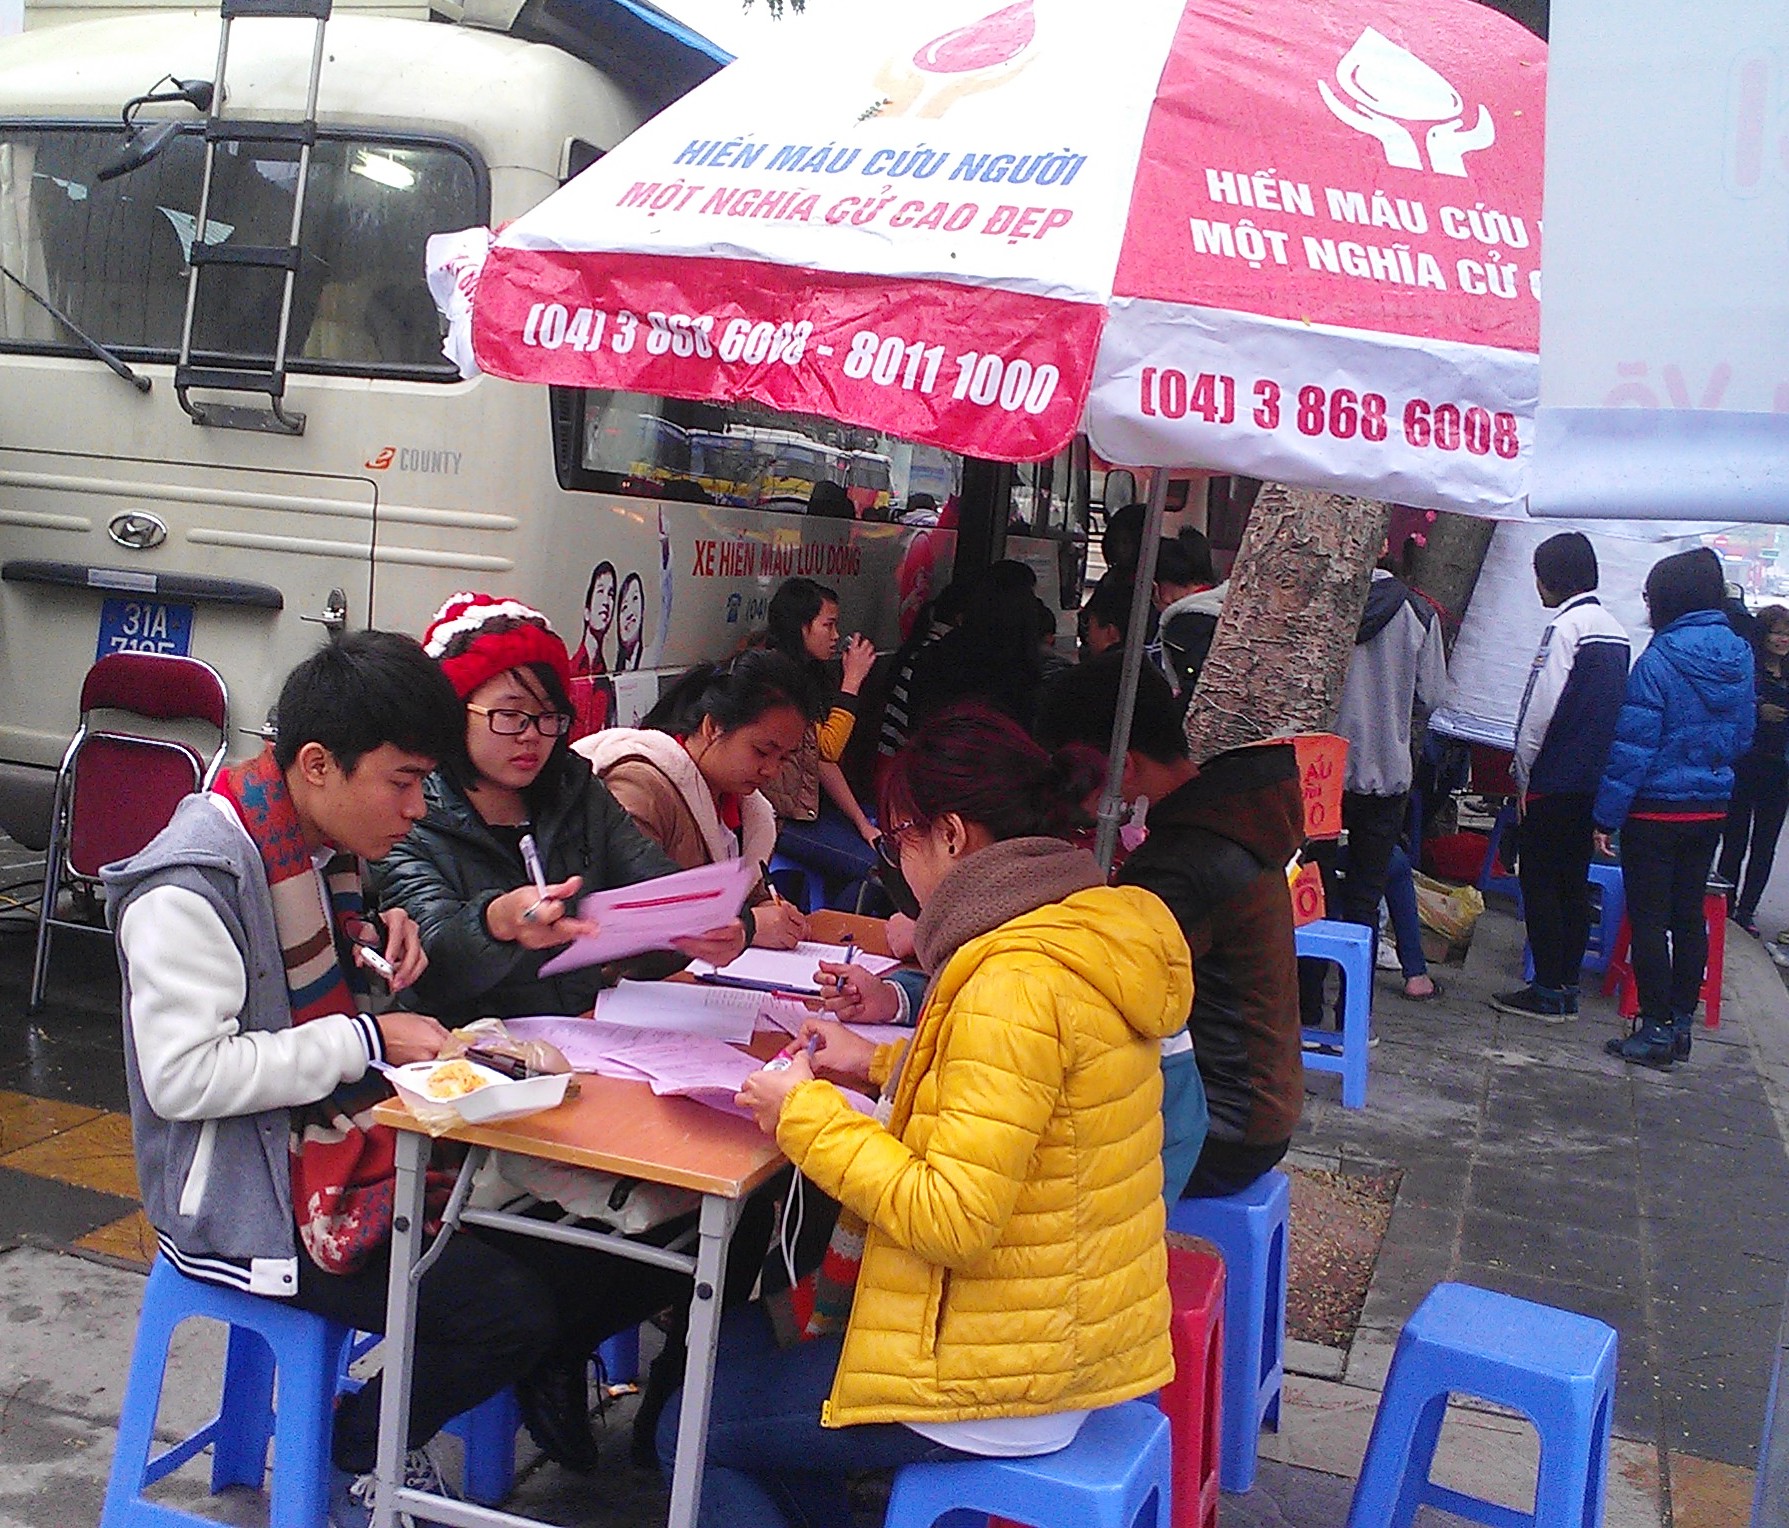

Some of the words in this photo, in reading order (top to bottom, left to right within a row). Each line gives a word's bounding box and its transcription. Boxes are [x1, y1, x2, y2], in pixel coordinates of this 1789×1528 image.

[672, 133, 767, 170] HIẾN
[765, 141, 860, 174] MÁU
[863, 143, 949, 179] CỨU
[949, 147, 1088, 186] NGƯỜI
[616, 179, 700, 217] MỘT
[699, 186, 822, 223] NGHĨA
[889, 200, 979, 234] CAO
[980, 205, 1074, 245] ĐẸP
[1204, 167, 1316, 217] HIẾN
[1324, 190, 1429, 235] MÁU
[1439, 202, 1530, 249] CỨU
[1189, 218, 1290, 269] MỘT
[1303, 236, 1447, 292] NGHĨA
[1456, 249, 1519, 299] CỬ
[612, 310, 638, 354] 3
[843, 330, 945, 394] 8011
[951, 351, 1060, 415] 1000
[1253, 379, 1281, 430] 3
[1297, 384, 1388, 442] 868
[1404, 398, 1520, 460] 6008
[400, 447, 462, 475] COUNTY
[692, 539, 716, 577] XE
[122, 602, 168, 639] 31A
